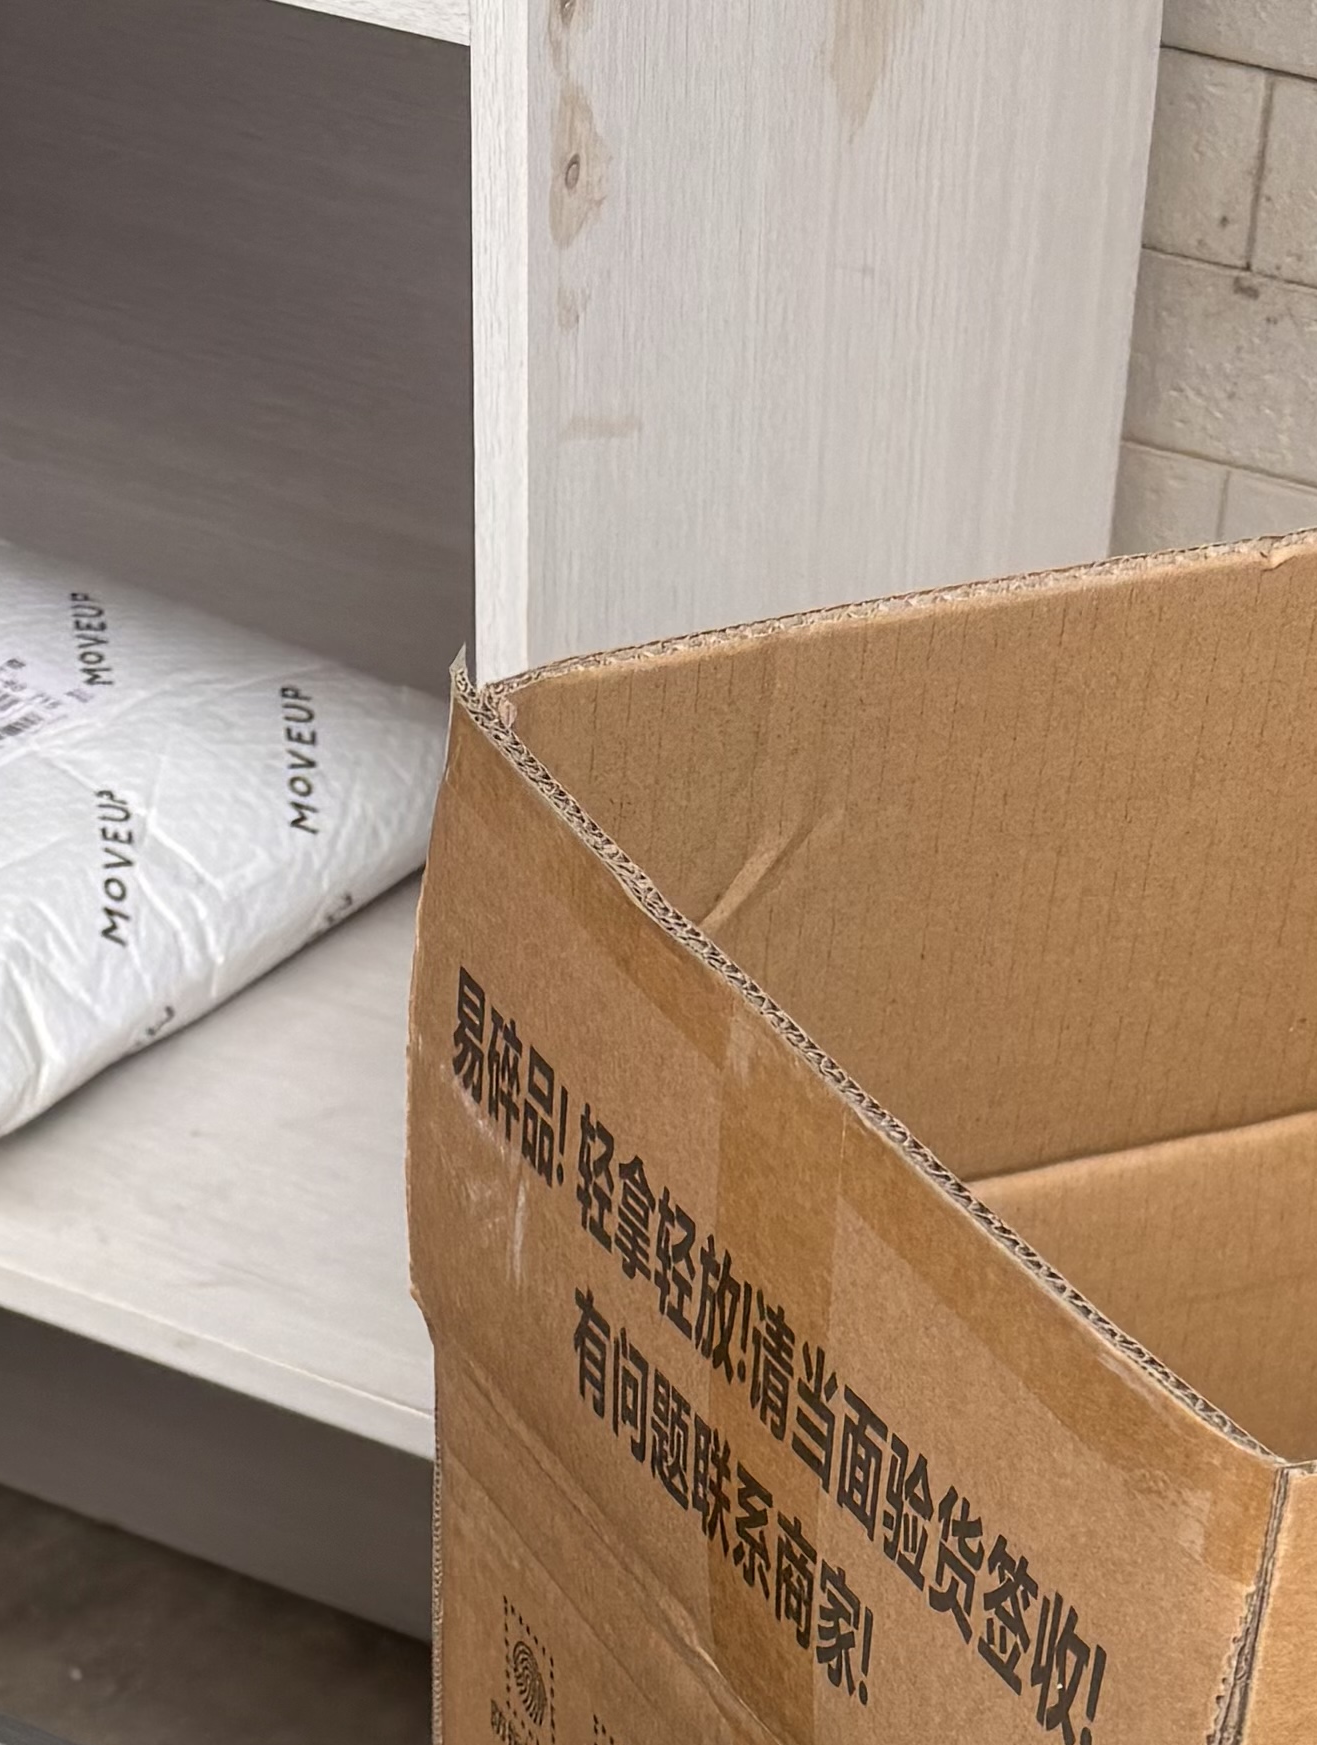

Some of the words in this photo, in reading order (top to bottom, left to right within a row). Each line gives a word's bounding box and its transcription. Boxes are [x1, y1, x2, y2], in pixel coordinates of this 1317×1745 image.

[71, 592, 113, 685] MOVEUP
[280, 687, 320, 835] MOVEUP
[93, 789, 135, 948] MOVEUP
[574, 1287, 874, 1706] 有问题联系商家!
